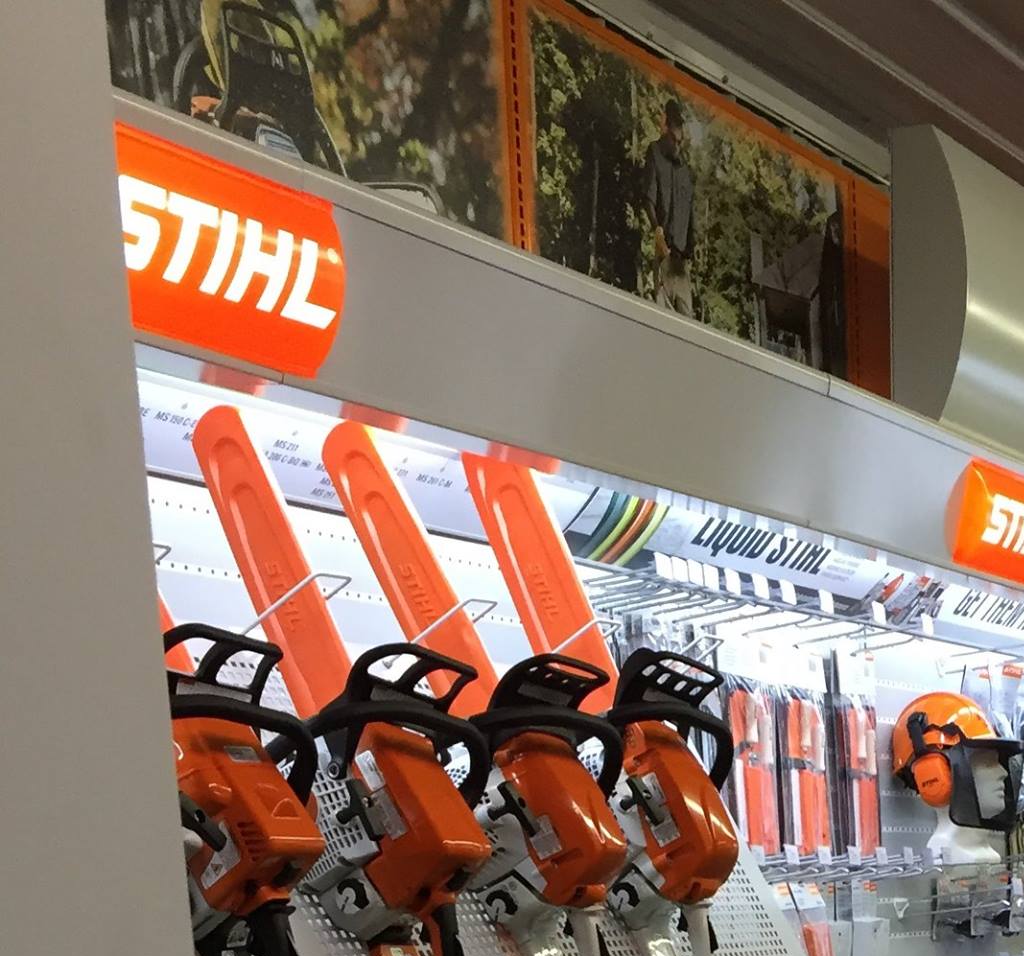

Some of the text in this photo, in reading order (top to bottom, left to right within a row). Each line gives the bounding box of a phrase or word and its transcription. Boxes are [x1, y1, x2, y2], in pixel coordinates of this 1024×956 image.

[119, 174, 338, 330] STIHL
[691, 516, 777, 558] LIQUID
[765, 536, 832, 575] STIHL
[953, 588, 990, 619] GET
